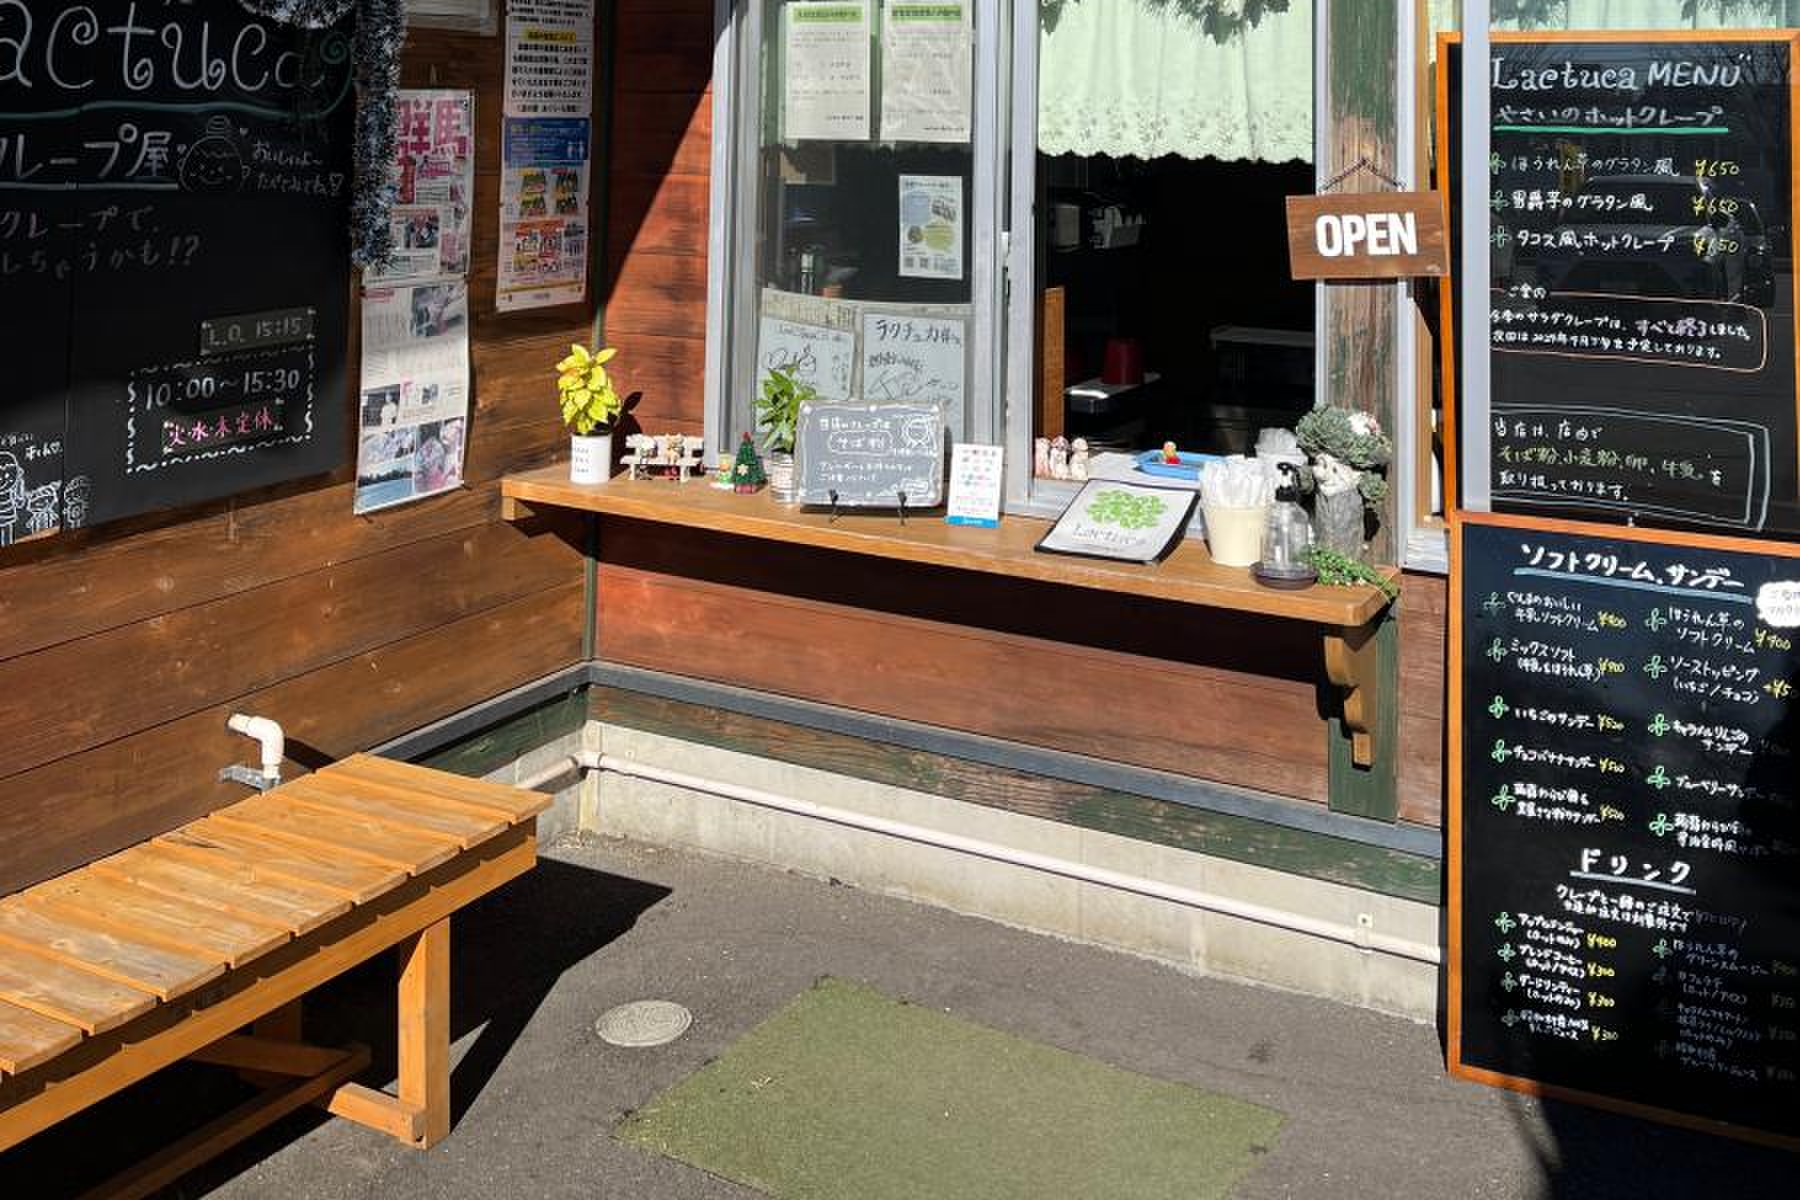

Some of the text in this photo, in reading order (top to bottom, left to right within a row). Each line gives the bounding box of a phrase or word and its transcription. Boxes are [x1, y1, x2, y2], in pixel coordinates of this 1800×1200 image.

[1492, 58, 1740, 90] Lactuca MENU
[1497, 106, 1723, 128] やさいのホットクレープ
[1316, 211, 1418, 257] OPEN
[255, 317, 303, 338] 15:15
[1677, 630, 1756, 654] ソフトクリーム
[1580, 847, 1692, 885] ドリンク
